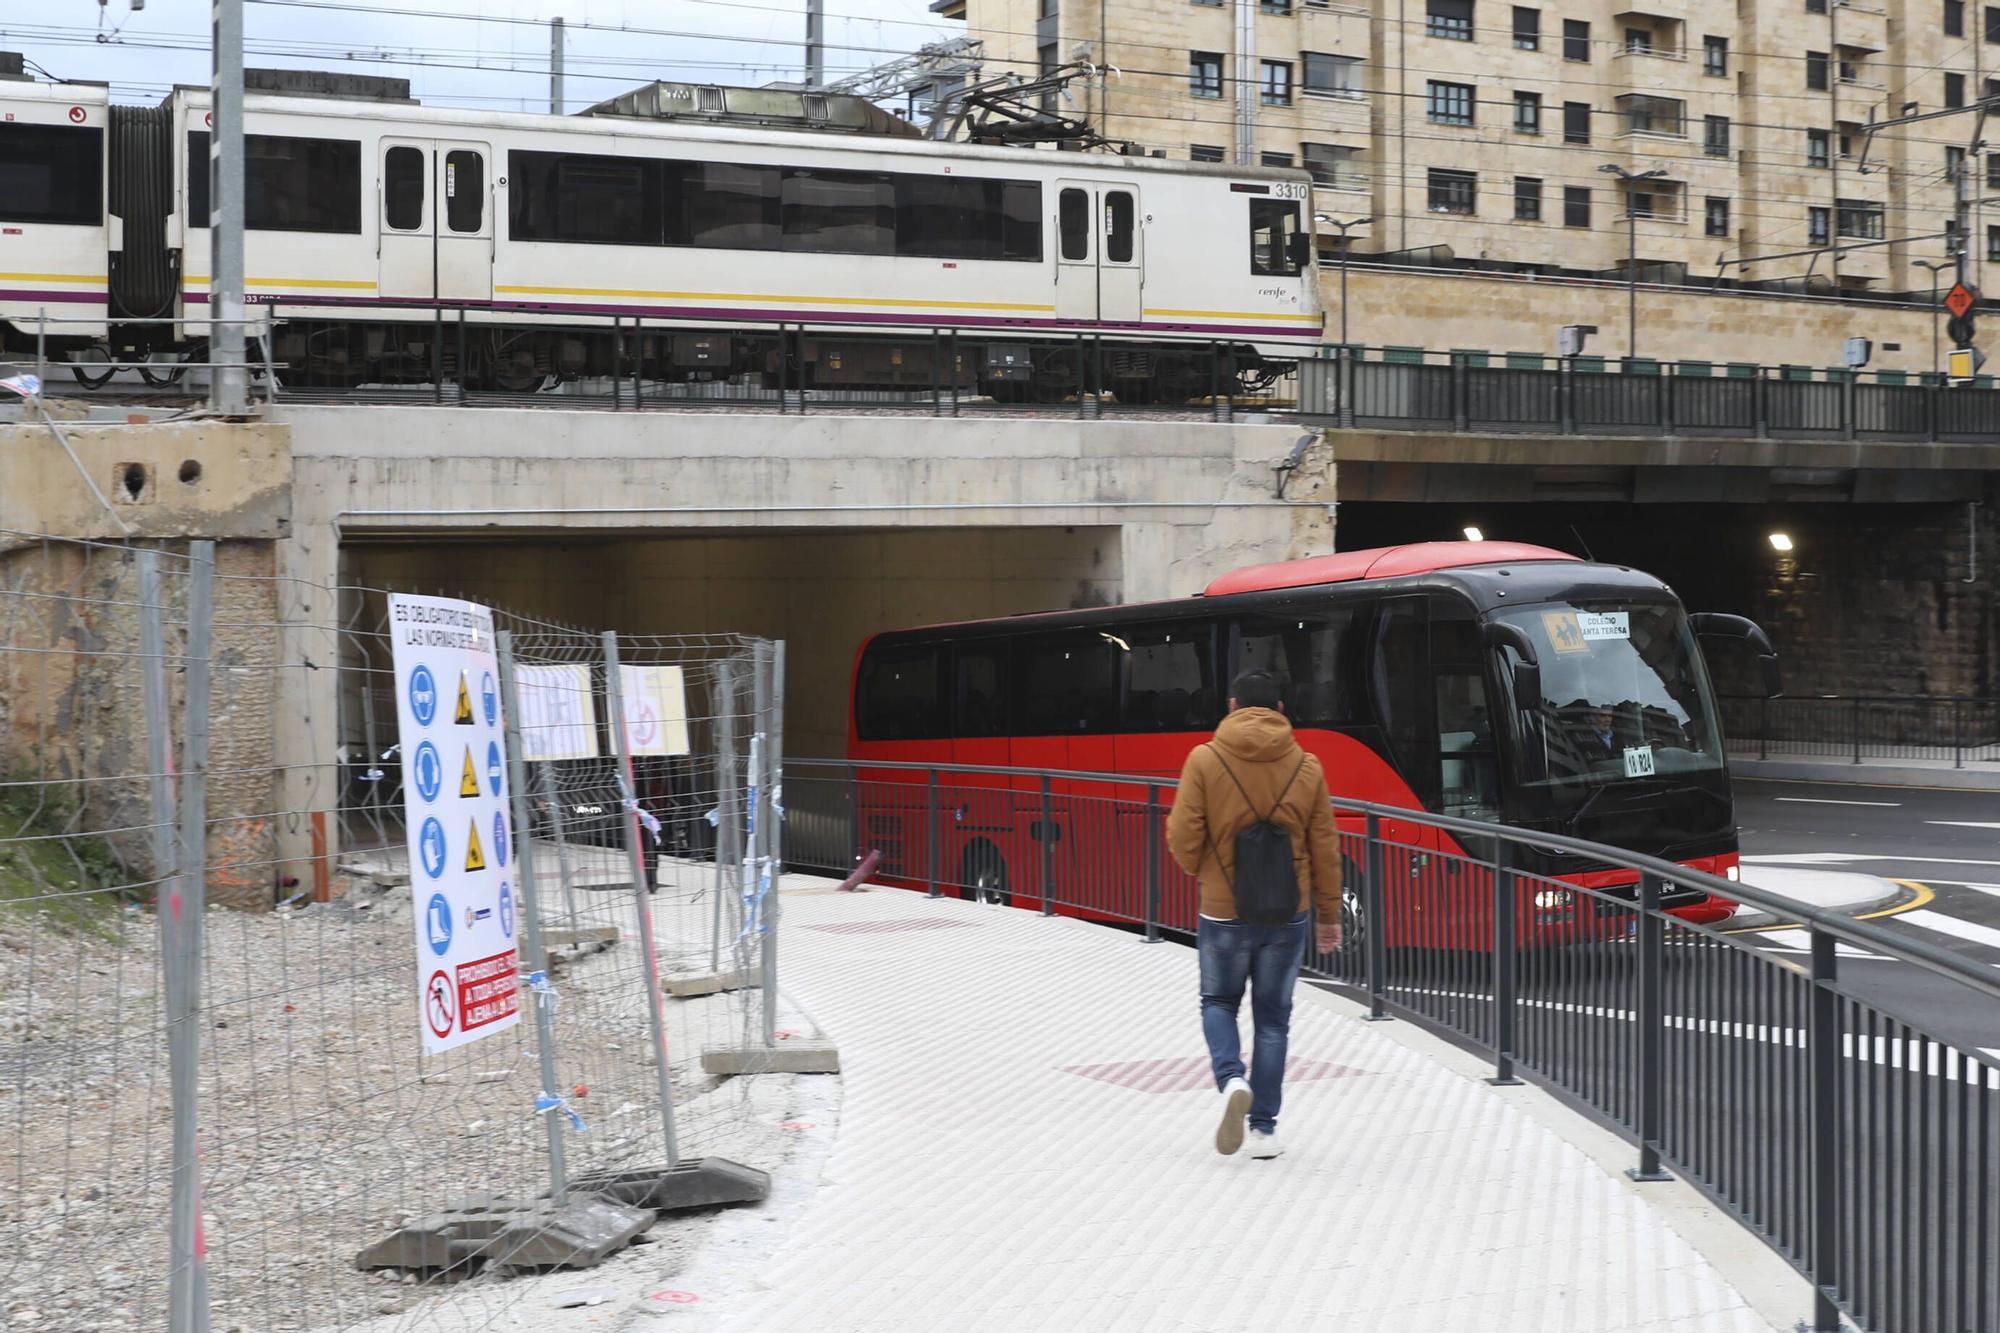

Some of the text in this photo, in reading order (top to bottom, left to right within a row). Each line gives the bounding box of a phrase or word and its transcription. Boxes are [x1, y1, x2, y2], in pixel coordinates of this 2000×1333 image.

[1276, 183, 1307, 199] 3310
[1258, 286, 1286, 299] renfe
[396, 603, 408, 621] ES
[1588, 617, 1616, 625] COLEGIO
[405, 628, 423, 645] LAS
[1602, 626, 1627, 634] TERESA
